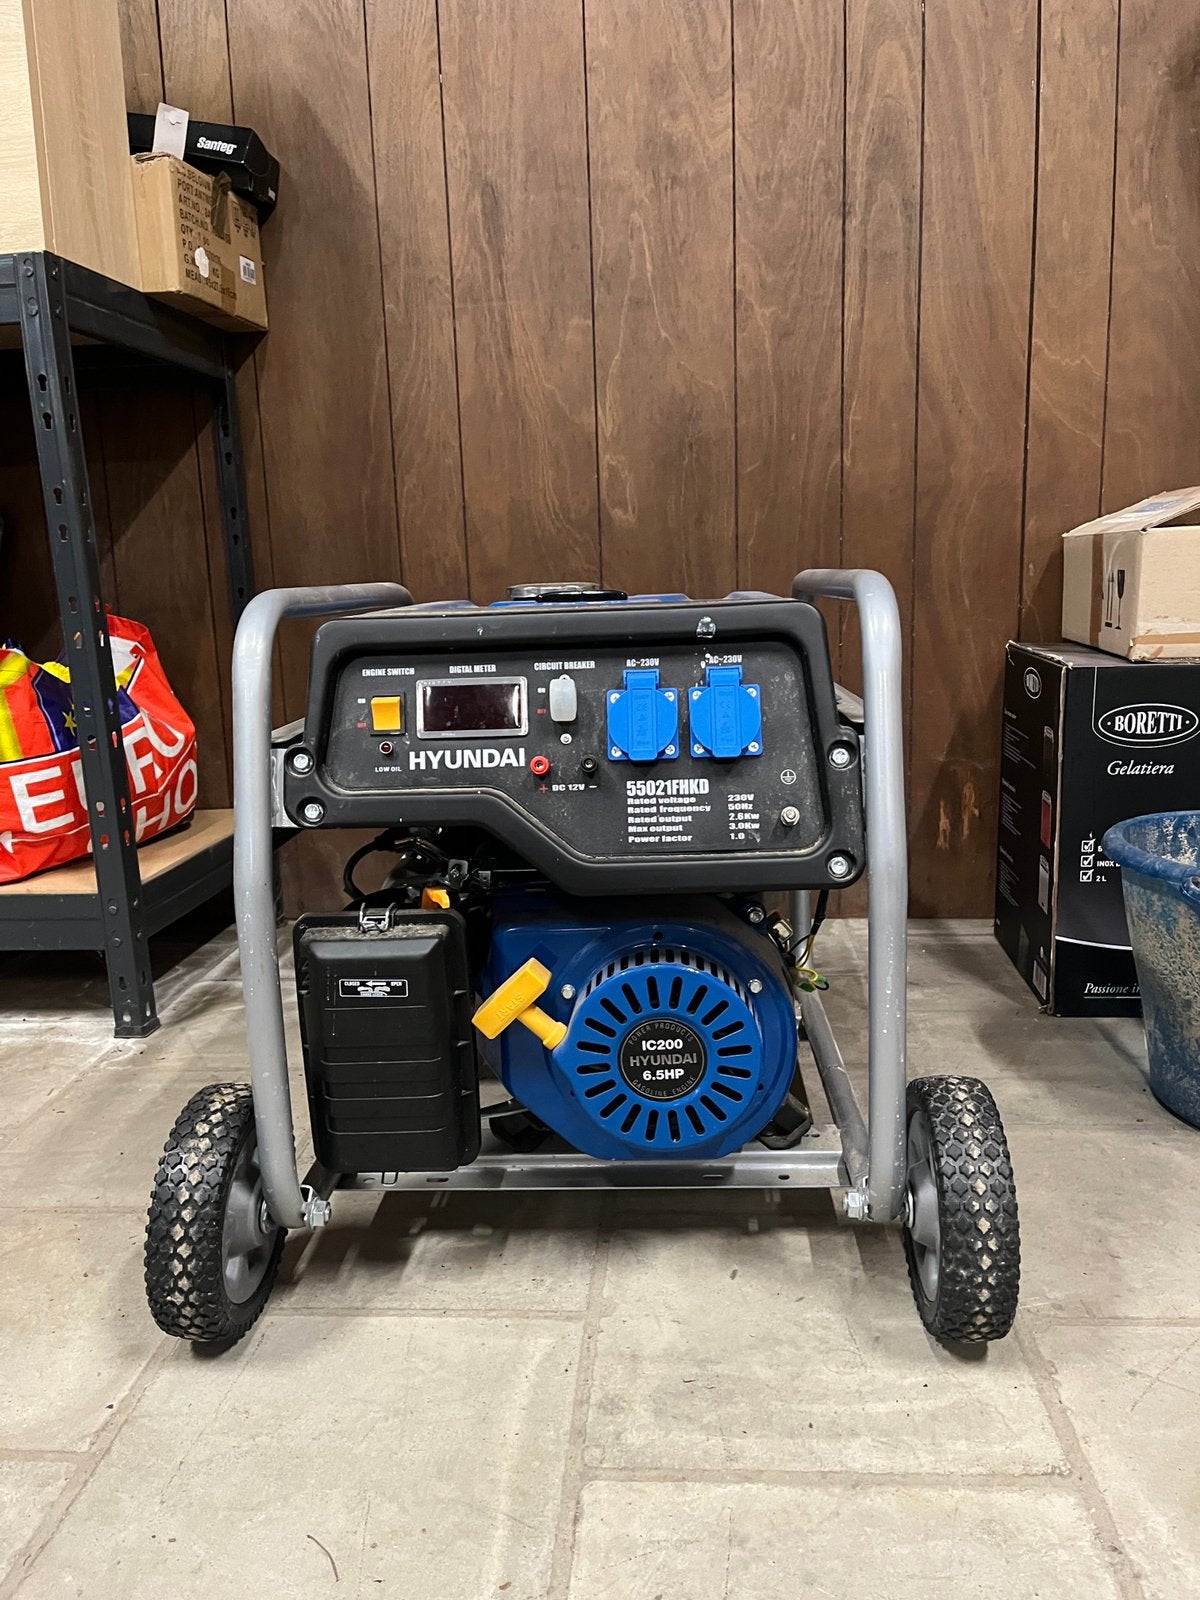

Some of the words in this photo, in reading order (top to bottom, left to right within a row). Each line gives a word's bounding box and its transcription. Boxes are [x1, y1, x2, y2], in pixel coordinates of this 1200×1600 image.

[196, 136, 237, 155] Santeg
[473, 664, 497, 673] METER
[534, 662, 563, 671] CIRCUIT
[564, 660, 596, 669] BREAKER
[362, 668, 387, 677] ENGINE
[387, 667, 415, 676] SWITCH
[1114, 711, 1183, 734] BORETTI
[408, 748, 526, 771] HYUNDAI
[1107, 759, 1175, 776] Gelatiera
[567, 783, 585, 791] 12V
[627, 797, 657, 805] Rated
[658, 796, 697, 805] voltage
[727, 793, 755, 802] 230V
[627, 805, 657, 814] Rated
[659, 804, 711, 814] frequency
[727, 803, 753, 811] 50Hz
[627, 815, 657, 823] Rated
[658, 815, 692, 823] output
[628, 825, 648, 833] Max
[649, 824, 683, 833] output
[628, 835, 660, 843] Power
[661, 834, 692, 843] factor
[729, 832, 745, 840] 1.0
[1084, 982, 1129, 994] Passione
[628, 1025, 652, 1045] POWER
[654, 1023, 694, 1042] PRODUCTS
[641, 1038, 684, 1051] IC200
[629, 1052, 698, 1067] HYUNDAI
[642, 1068, 685, 1081] 6.5HP
[632, 1079, 668, 1097] GASOLINE
[671, 1076, 696, 1095] ENGINE
